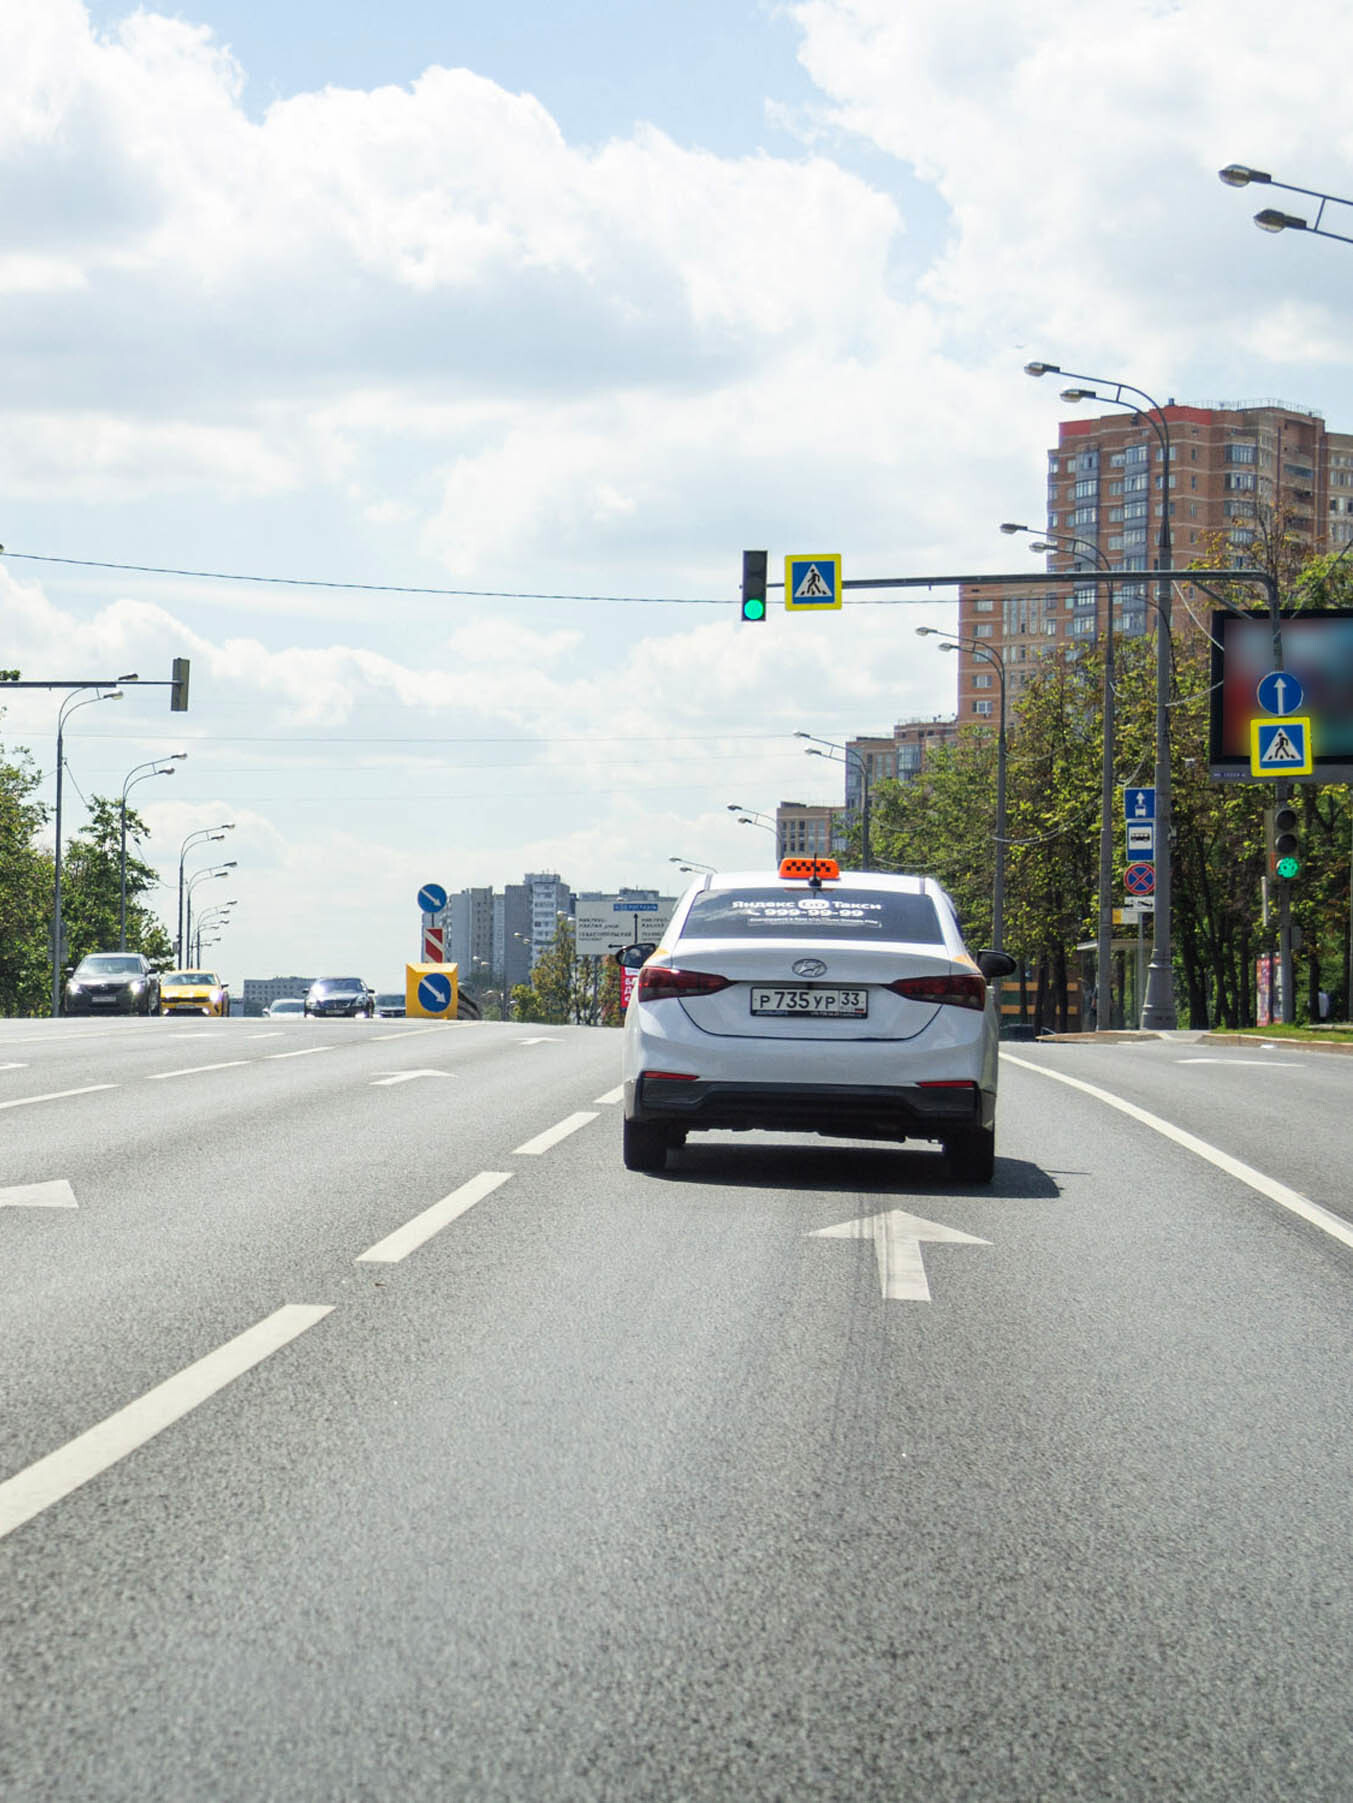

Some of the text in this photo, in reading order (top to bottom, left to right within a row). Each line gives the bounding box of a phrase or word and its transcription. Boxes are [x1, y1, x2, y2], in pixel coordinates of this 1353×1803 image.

[732, 901, 795, 909] Яндекс
[832, 901, 882, 910] Такси
[764, 909, 864, 917] 999-99-99
